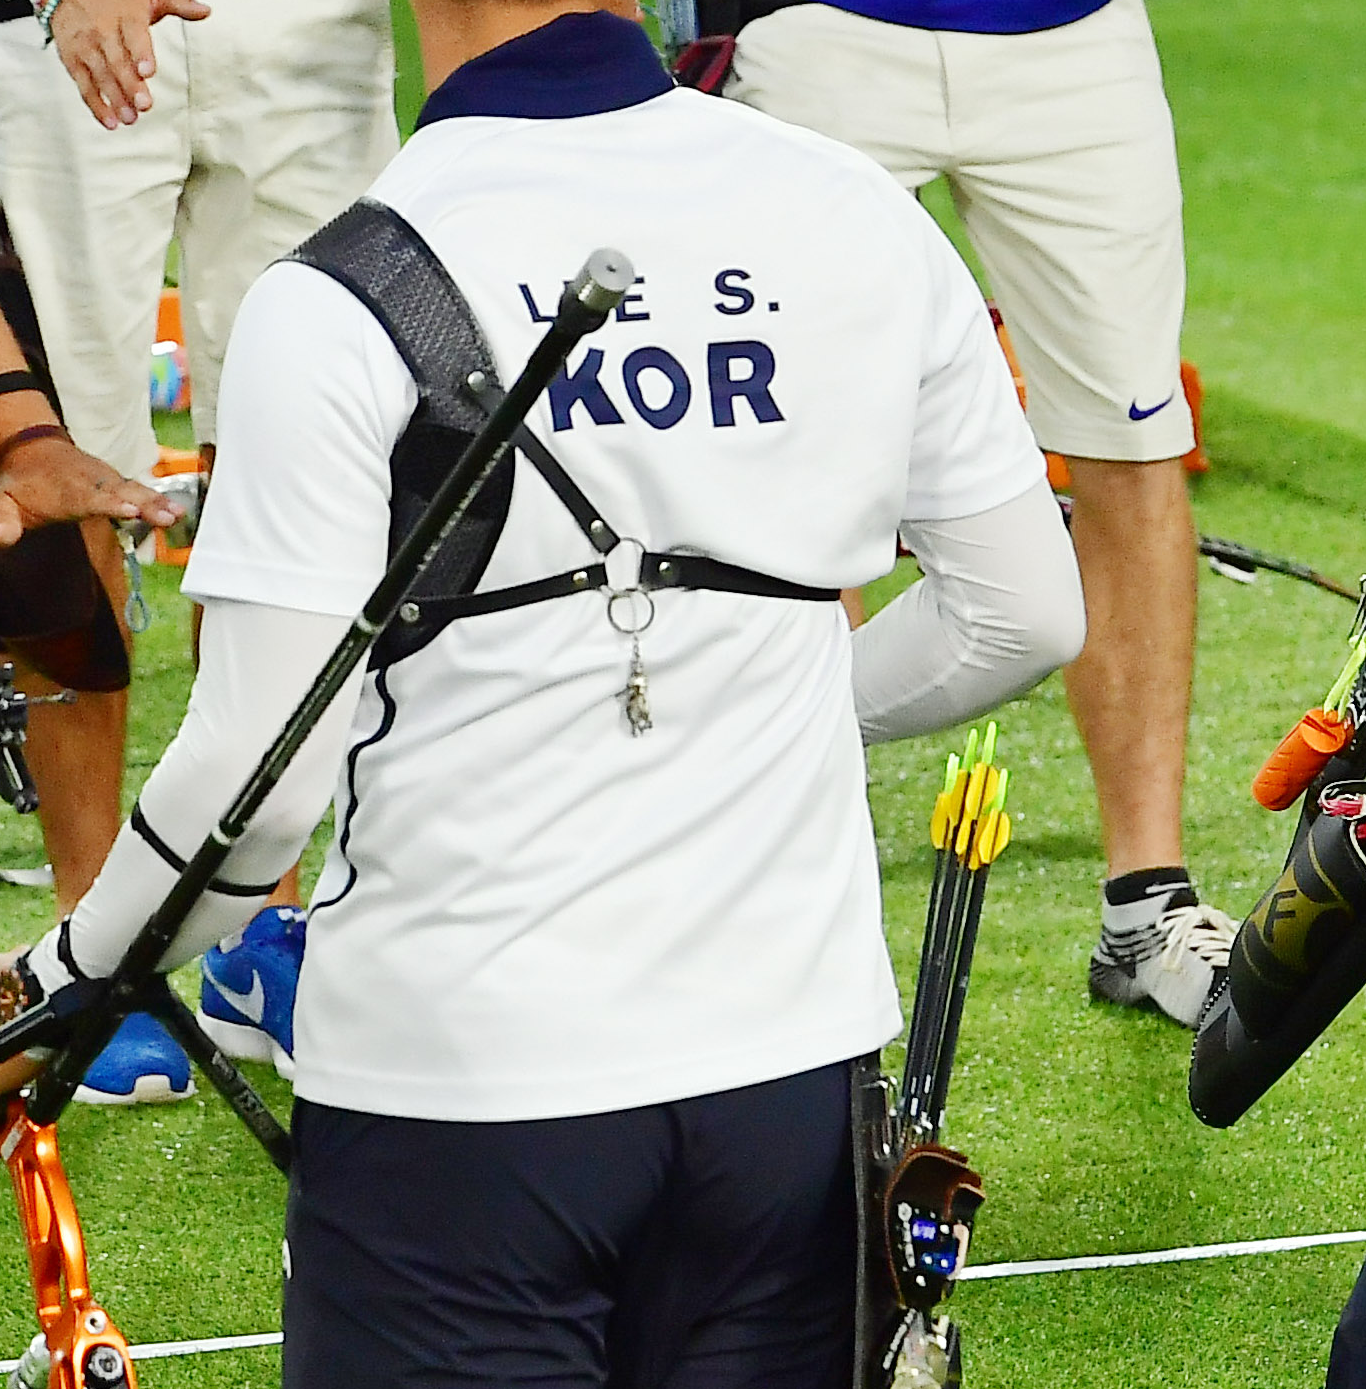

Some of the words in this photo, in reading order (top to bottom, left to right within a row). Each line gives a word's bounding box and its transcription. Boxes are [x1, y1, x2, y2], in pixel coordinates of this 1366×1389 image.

[517, 276, 651, 323] LE
[712, 268, 781, 316] S.
[547, 340, 787, 431] KOR
